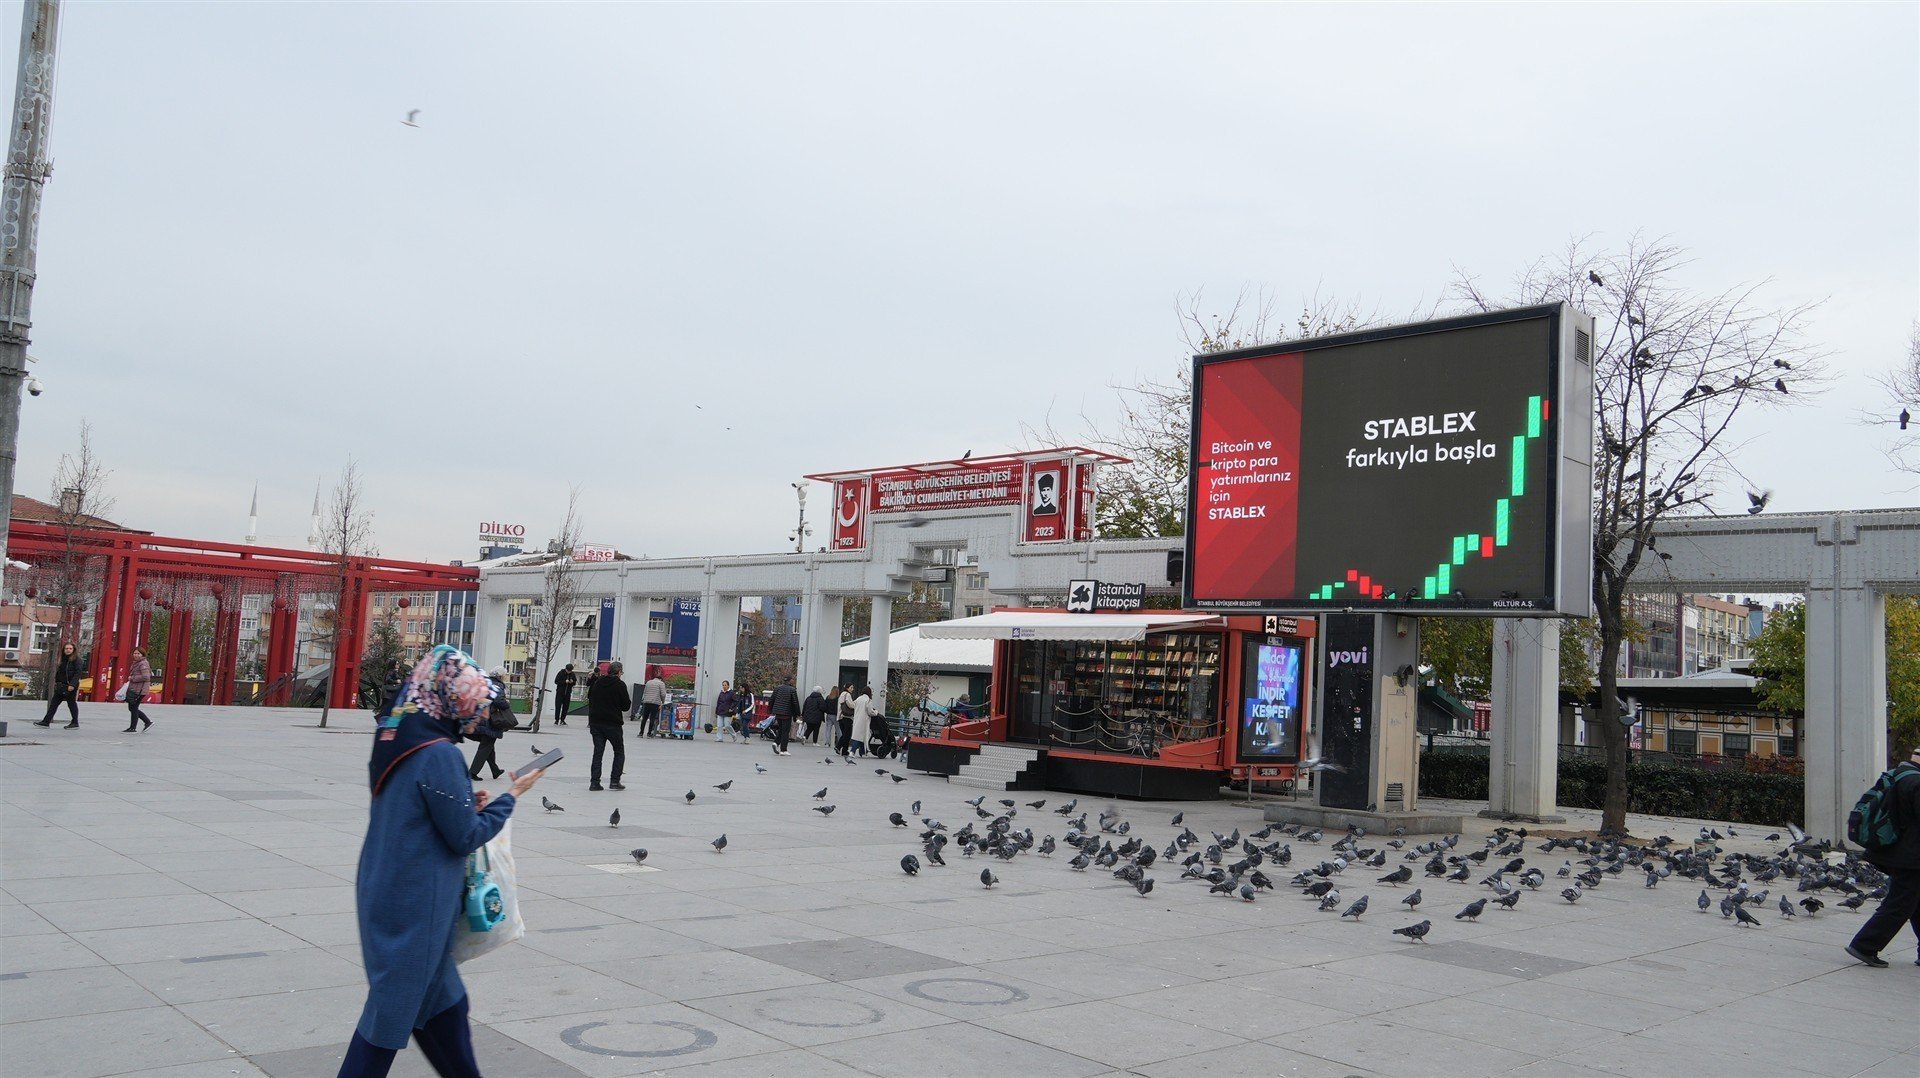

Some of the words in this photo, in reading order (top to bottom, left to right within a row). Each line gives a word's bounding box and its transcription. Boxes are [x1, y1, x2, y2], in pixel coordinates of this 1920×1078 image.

[1363, 410, 1476, 441] STABLEX
[1211, 439, 1254, 454] Bitcoin
[1257, 440, 1272, 450] ve
[1345, 444, 1428, 470] farkıyla
[1435, 438, 1496, 465] başla
[1210, 457, 1247, 473] kripto
[1249, 456, 1278, 471] para
[878, 480, 914, 492] İSTANBUL
[915, 474, 964, 489] BÜYÜKŞEHİR
[964, 469, 1011, 485] BELEDİYESİ
[1210, 471, 1291, 490] yatırımlarınız
[916, 489, 967, 503] CUMHURİYET
[969, 487, 1008, 500] MEYDANI
[1209, 489, 1231, 505] için
[1208, 505, 1266, 520] STABLEX
[479, 521, 525, 537] DİLKO
[1034, 526, 1054, 537] 2023
[839, 537, 854, 546] 1923
[588, 549, 612, 558] SRC
[1097, 581, 1142, 595] istanbul
[680, 602, 696, 610] 0212
[1096, 596, 1140, 610] kitapçısı
[1329, 646, 1367, 668] yovi
[1258, 683, 1286, 701] İNDİR
[1251, 704, 1290, 721] KEŞFET
